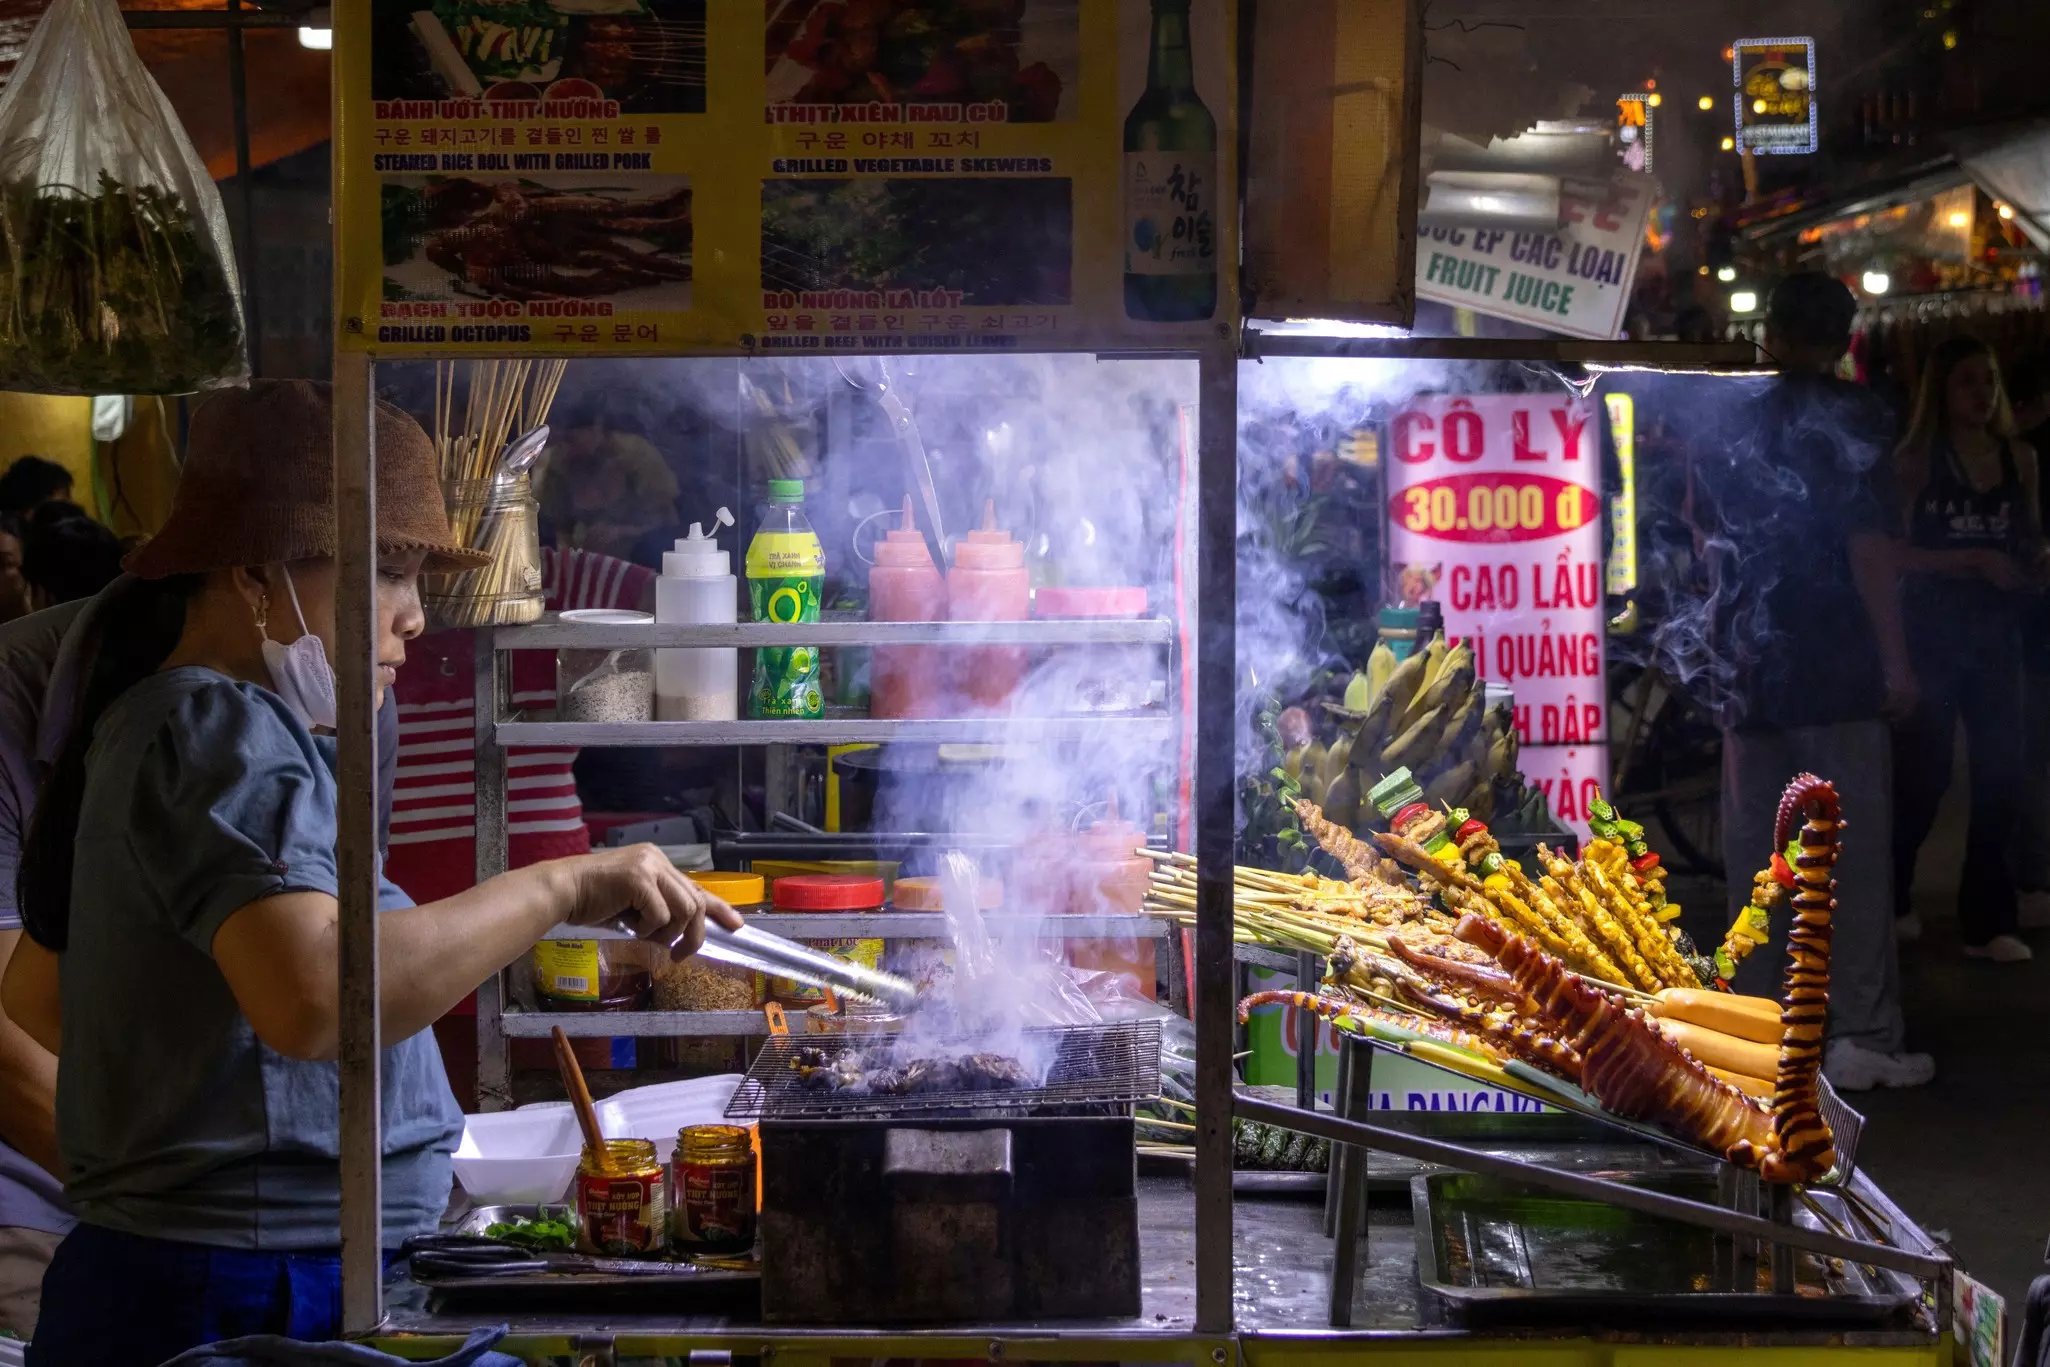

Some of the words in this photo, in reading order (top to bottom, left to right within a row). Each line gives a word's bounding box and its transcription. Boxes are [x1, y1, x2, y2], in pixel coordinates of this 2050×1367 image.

[908, 104, 960, 123] RAU
[374, 128, 412, 145] 구운
[796, 132, 848, 150] 구운
[863, 131, 914, 150] 야채
[928, 131, 980, 149] 꼬치
[374, 154, 437, 171] STEAMED
[442, 154, 473, 171] RICE
[478, 154, 509, 171] ROLL
[514, 153, 550, 171] WITH
[555, 153, 609, 170] GRILLED
[614, 153, 652, 170] PORK
[773, 158, 848, 173] GRILLED
[854, 158, 955, 173] VEGETABLE
[960, 158, 1052, 173] SKEWERS
[1426, 251, 1501, 297] FRUIT
[1502, 270, 1575, 317] JUICE
[916, 314, 969, 331] 구운
[379, 325, 445, 343] GRILLED
[451, 325, 531, 342] OCTOPUS
[554, 325, 600, 342] 구운
[611, 323, 658, 342] 문어
[761, 335, 820, 348] GRILLED
[861, 335, 902, 348] WITH
[1392, 399, 1484, 465] CÔ
[1404, 485, 1544, 531] 30.000
[1556, 484, 1582, 530] đ
[1451, 563, 1519, 612] CAO
[1497, 617, 1600, 684] QUẢNG
[1541, 694, 1601, 758] ĐẬP
